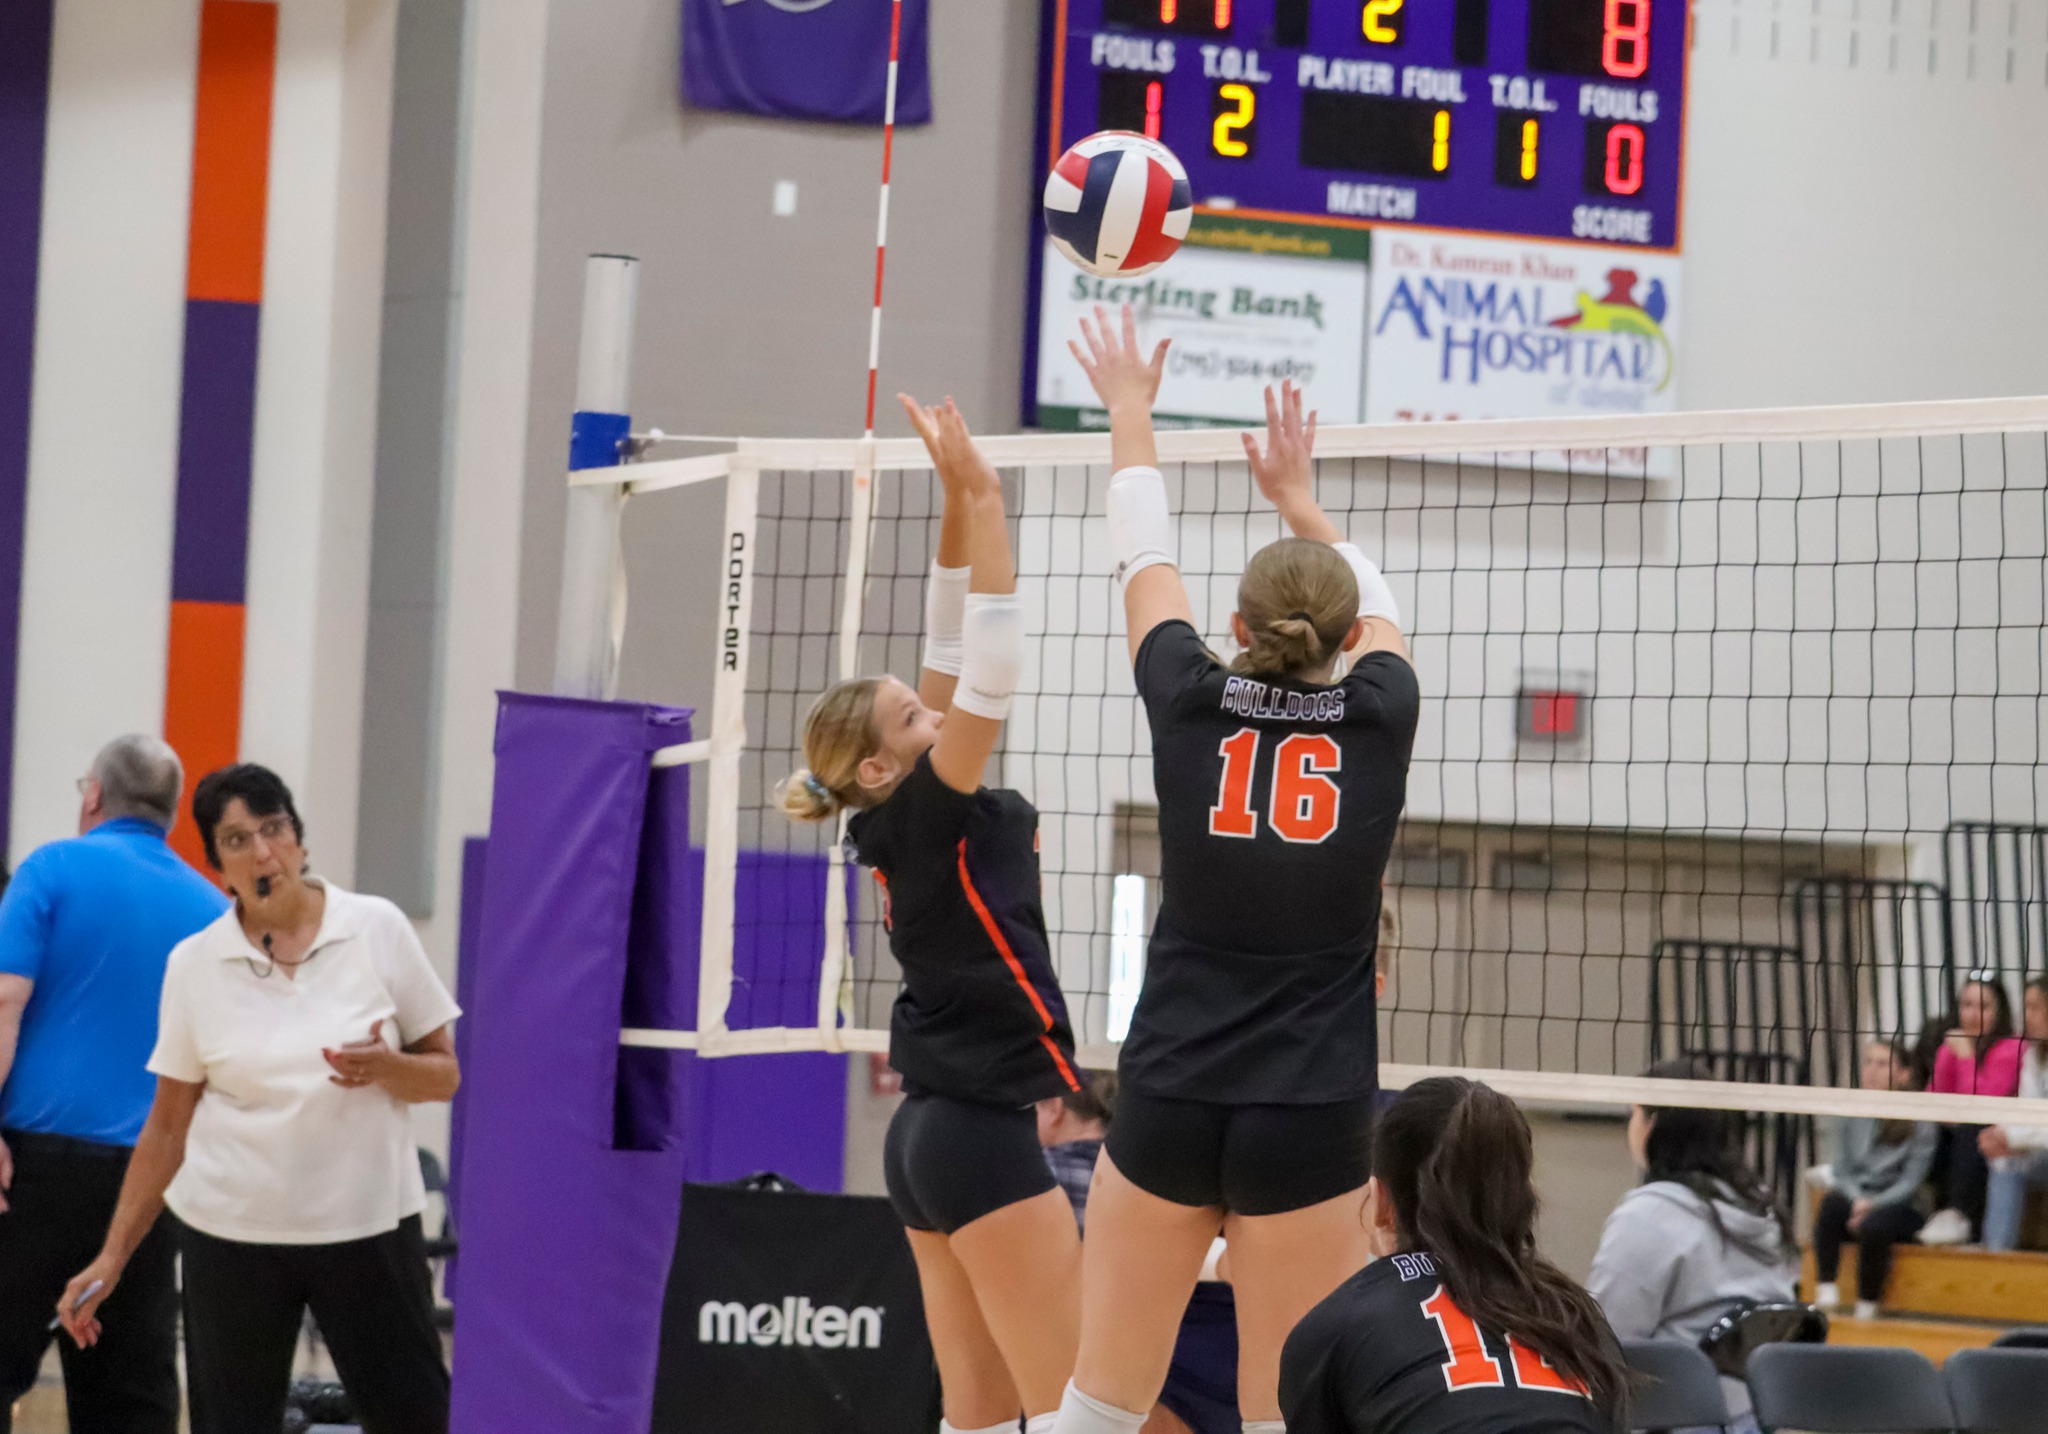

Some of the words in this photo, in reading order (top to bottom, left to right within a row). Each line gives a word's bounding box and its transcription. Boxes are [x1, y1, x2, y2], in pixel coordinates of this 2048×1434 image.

[1091, 33, 1176, 73] FOULS
[1602, 0, 1651, 78] 8
[1298, 54, 1395, 96] PLAYER
[1402, 65, 1468, 103] FOUL
[1579, 83, 1659, 123] FOULS
[1145, 81, 1162, 139] 1
[1212, 83, 1255, 157] 2
[1432, 110, 1450, 172] 1
[1520, 119, 1539, 180] 1
[1605, 124, 1645, 195] 0
[1326, 180, 1417, 220] MATCH
[1572, 204, 1653, 243] SCORE
[1071, 273, 1218, 318] Sterling
[1230, 284, 1325, 329] Bank
[1375, 275, 1550, 340] ANIMAL
[1440, 324, 1656, 385] HOSPITAL
[723, 532, 745, 671] PORTER
[1220, 676, 1346, 721] BULLDOGS
[1209, 727, 1342, 844] 16
[698, 1296, 881, 1348] molten
